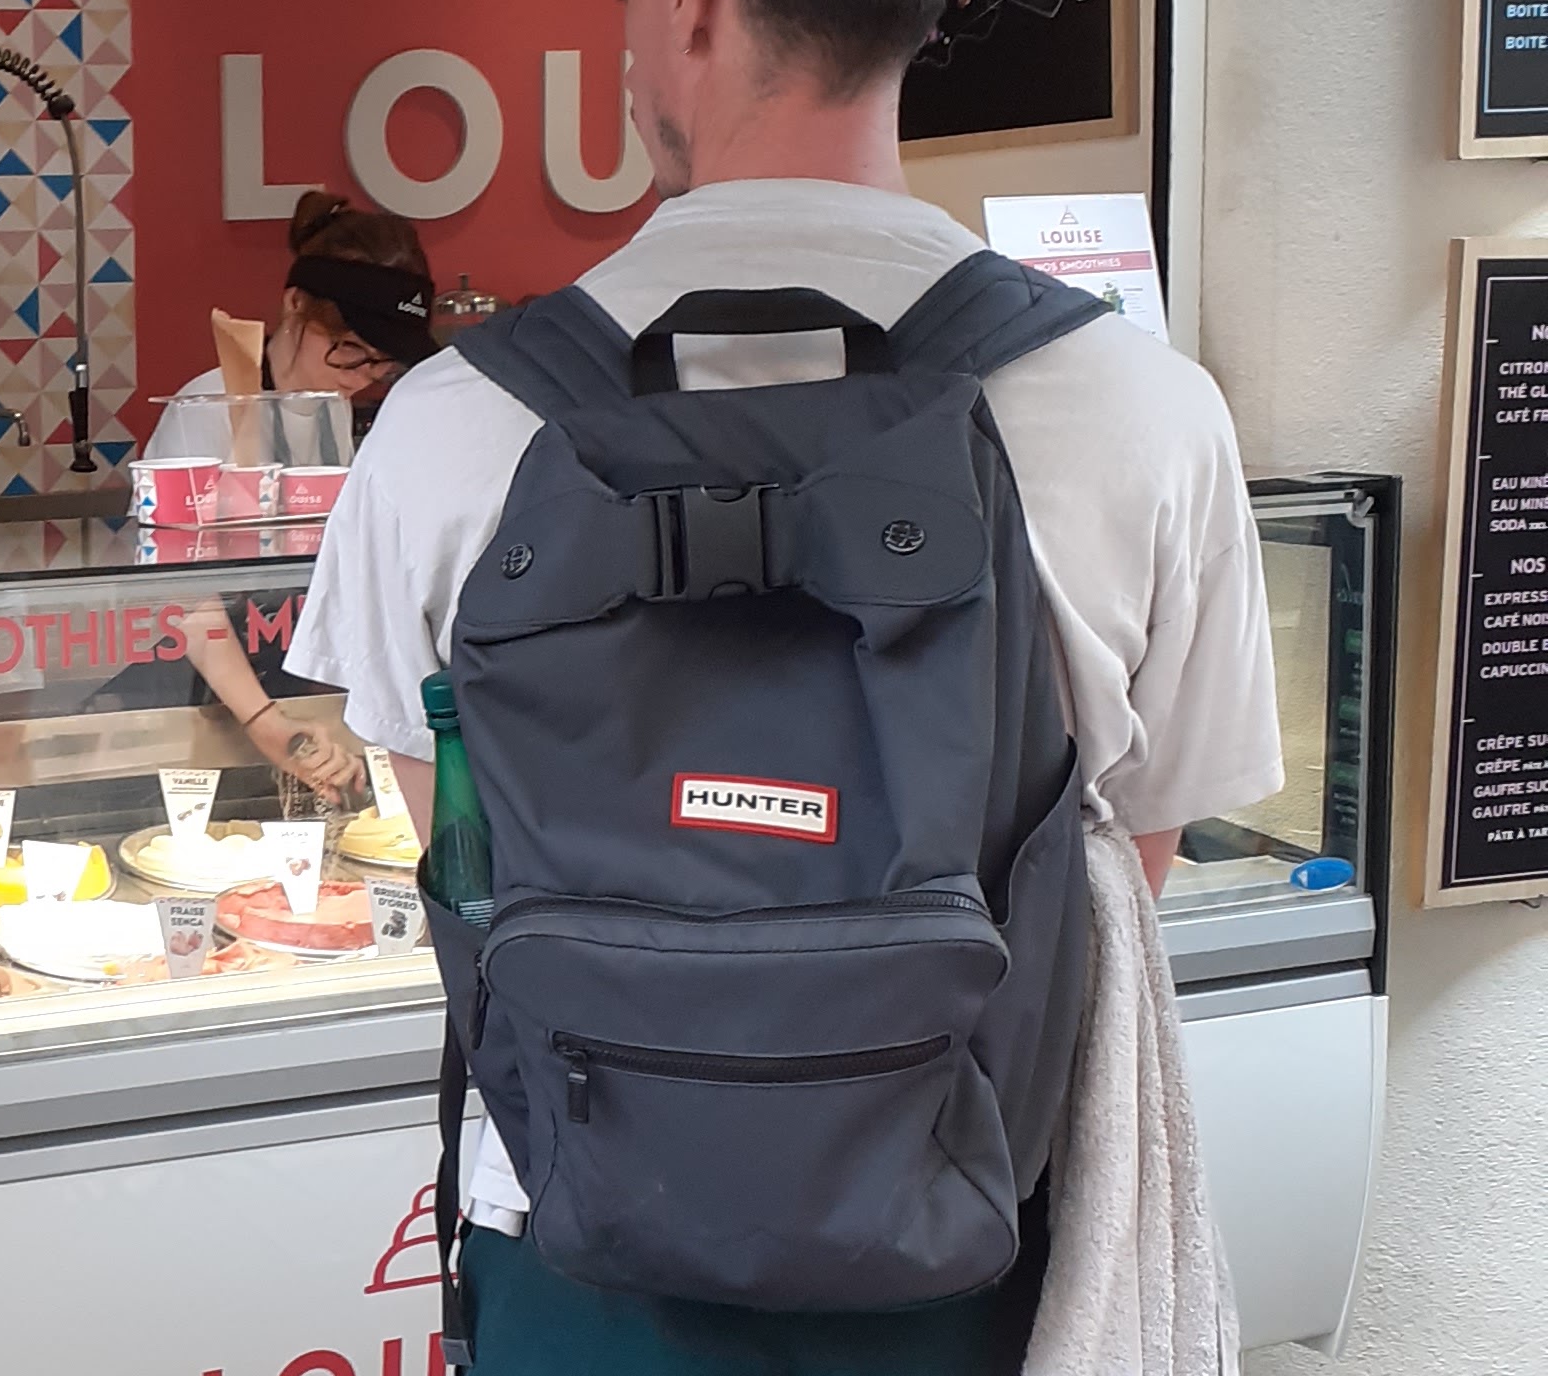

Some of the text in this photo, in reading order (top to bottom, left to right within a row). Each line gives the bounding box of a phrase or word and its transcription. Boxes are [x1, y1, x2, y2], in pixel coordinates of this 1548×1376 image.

[1040, 228, 1104, 245] LOUISE
[1058, 257, 1122, 271] SMOOTHIES
[1498, 382, 1527, 400] THÉ
[1496, 407, 1530, 423] CAFÉ
[1492, 477, 1518, 491] EAU
[1490, 498, 1518, 512] EAU
[1489, 518, 1527, 533] SODA
[1511, 557, 1546, 575] NOS
[247, 593, 308, 655] M
[1483, 612, 1520, 629] CAFÉ
[1481, 639, 1539, 656] DOUBLE
[1476, 734, 1524, 752] CRÊPE
[1475, 758, 1521, 775] CRÊPE
[172, 777, 208, 786] VANILLE
[1473, 782, 1525, 799] GAUFRE
[686, 789, 824, 819] HUNTER
[1472, 802, 1532, 819] GAUFRE
[170, 906, 205, 916] FRAISE
